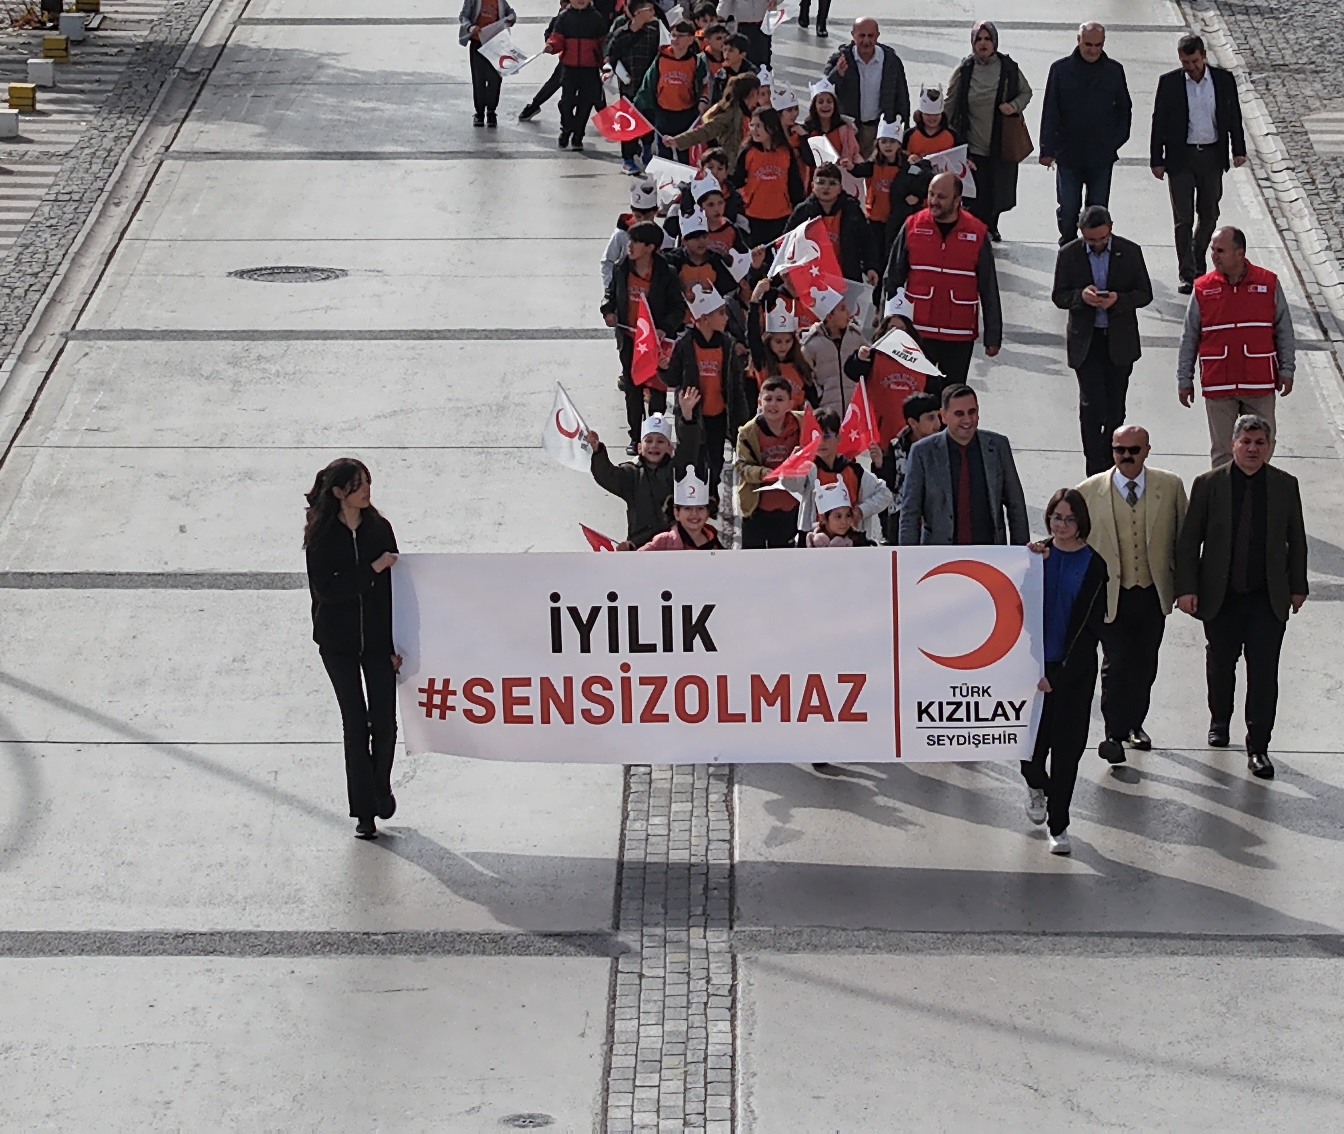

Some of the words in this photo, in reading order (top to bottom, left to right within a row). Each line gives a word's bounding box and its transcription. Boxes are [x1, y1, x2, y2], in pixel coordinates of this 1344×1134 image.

[548, 590, 718, 654] İYİLİK
[417, 661, 869, 726] #SENSİZOLMAZ
[949, 682, 992, 698] TÜRK
[916, 699, 1028, 723] KIZILAY
[925, 731, 1019, 749] SEYDİŞEHİR
